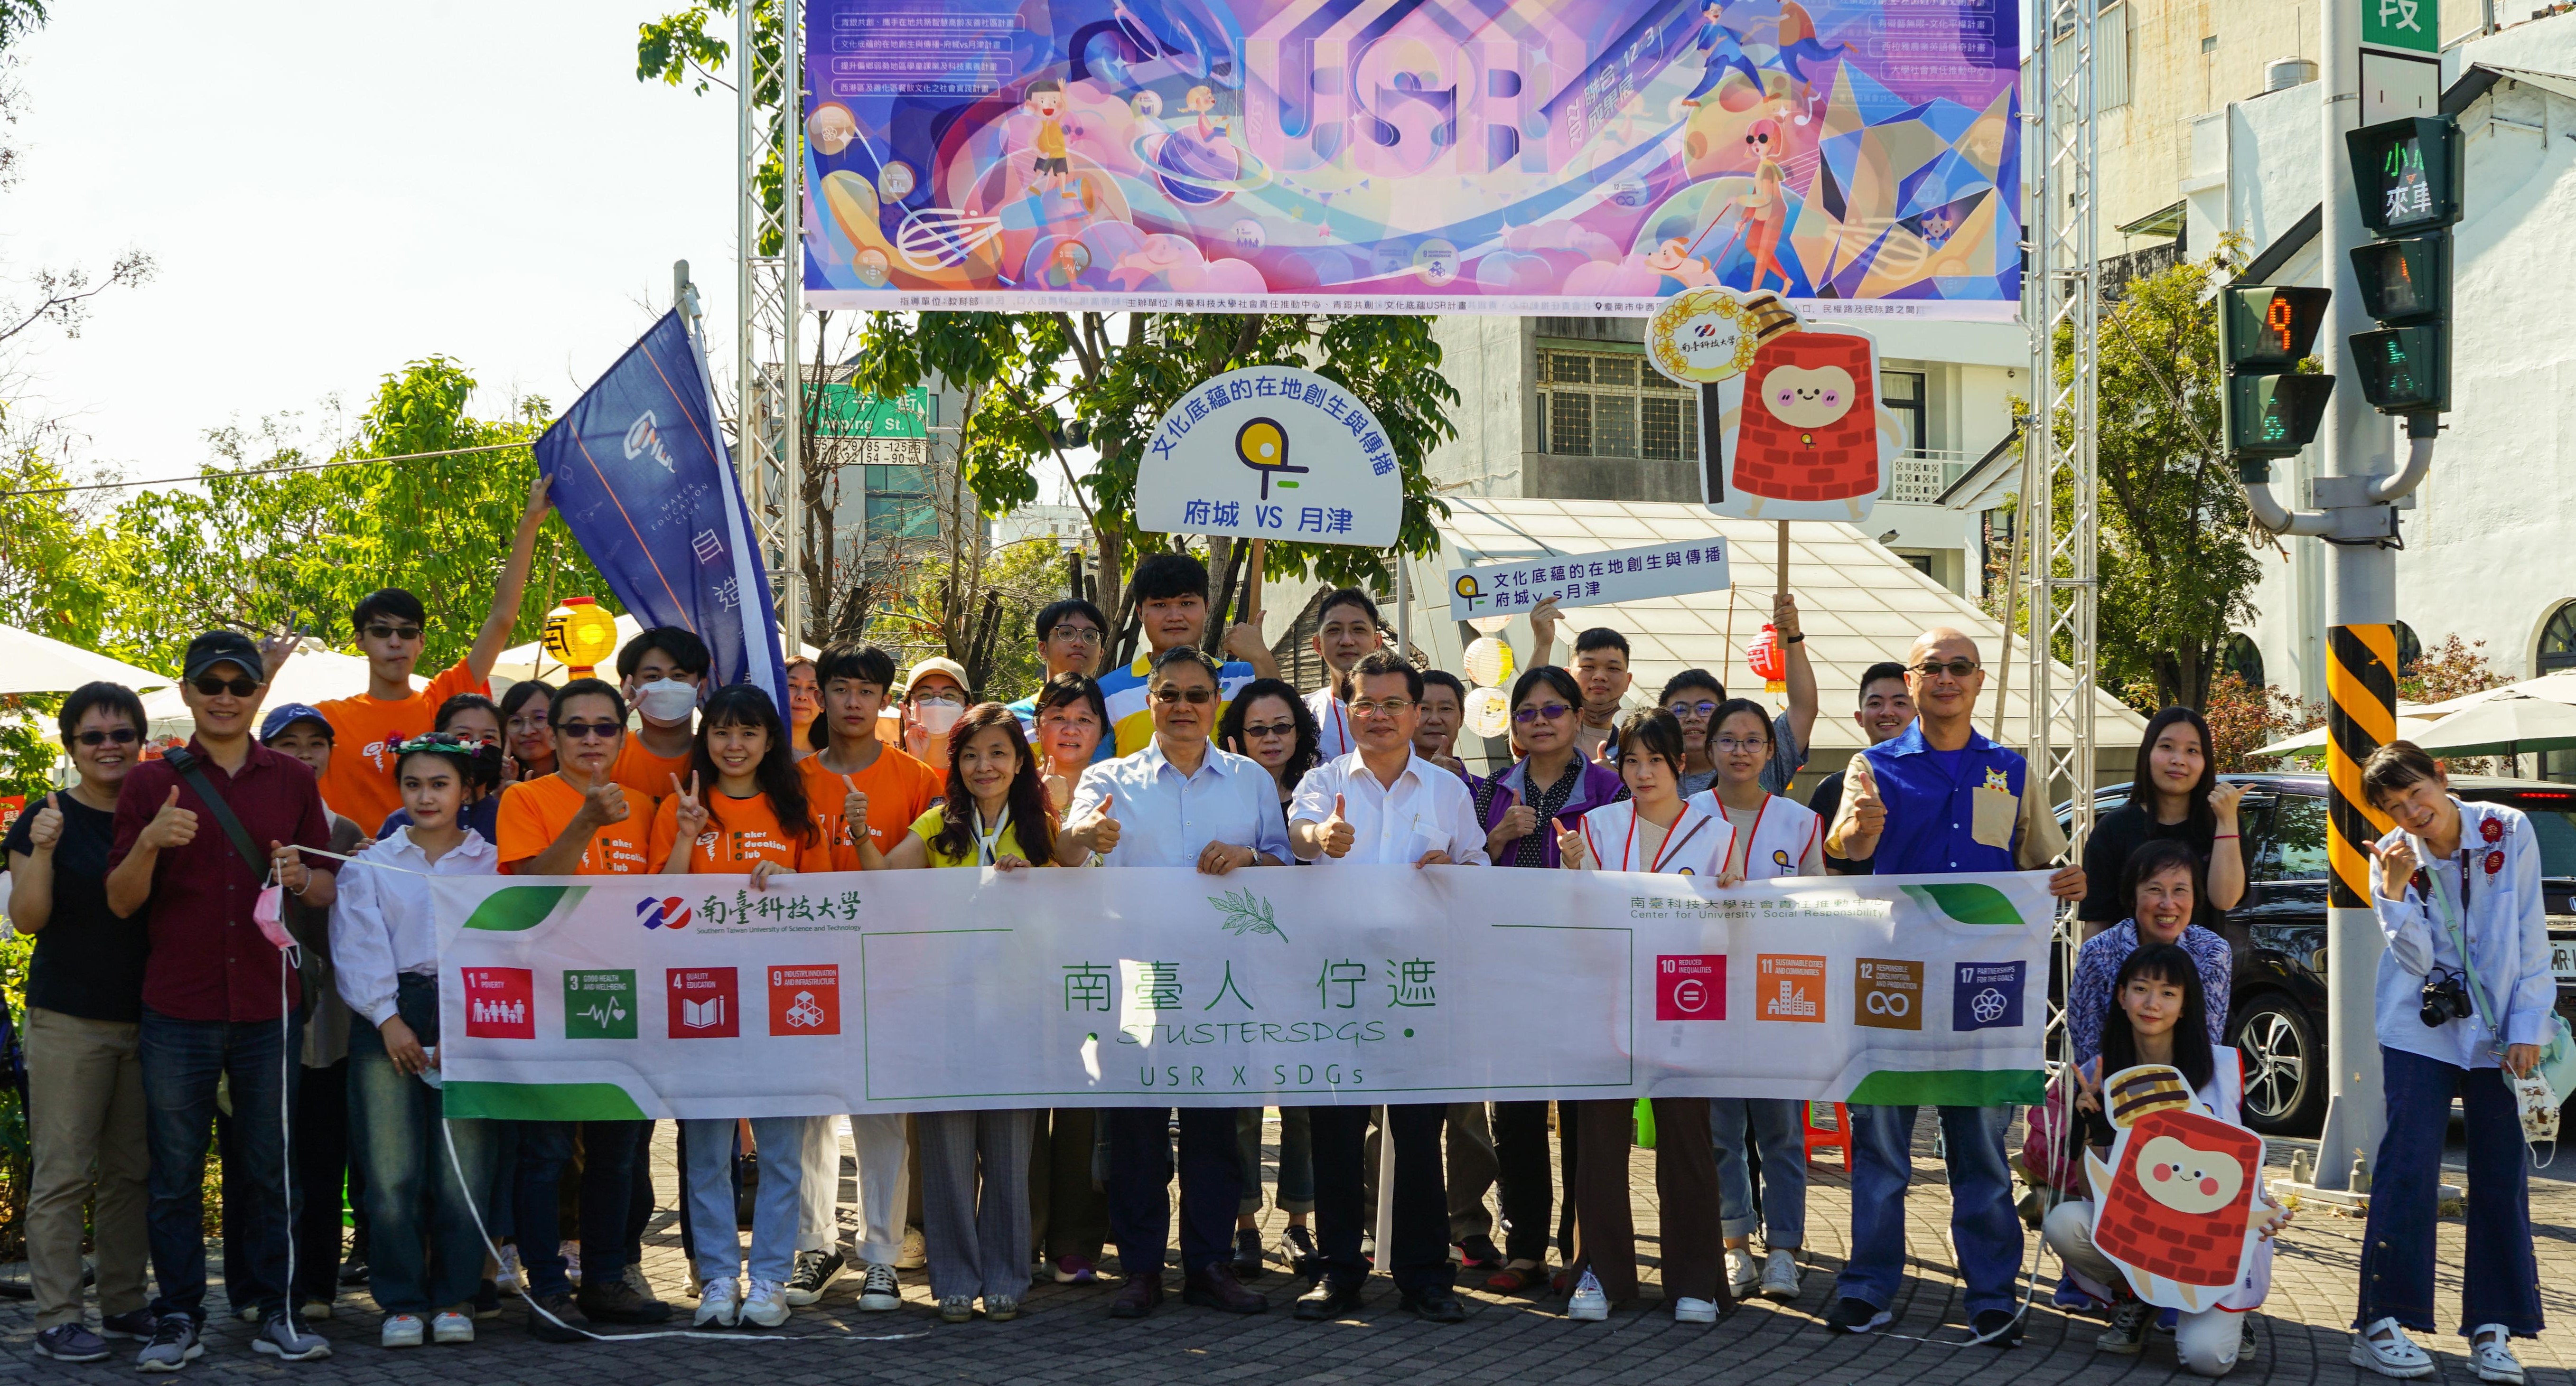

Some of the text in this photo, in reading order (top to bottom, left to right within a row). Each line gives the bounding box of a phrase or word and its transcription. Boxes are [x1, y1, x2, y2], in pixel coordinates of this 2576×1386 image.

[2268, 297, 2291, 350] 9
[885, 418, 905, 431] St.
[662, 483, 695, 512] MAKER
[651, 483, 709, 531] EDUCATION
[675, 503, 700, 525] CLUB
[1184, 499, 1353, 534] 府城 VS 月津
[1494, 546, 1721, 589] 文化底蘊的在地創生與傳播
[696, 890, 861, 925] 南臺科技大學
[1631, 897, 1886, 909] 南臺科技大學社會責任推動中心
[1631, 908, 1885, 920] Center for University Social Responsibility
[749, 926, 780, 934] University
[826, 924, 861, 933] Technology
[1661, 959, 1675, 973] 10
[1762, 959, 1772, 974] 11
[1775, 959, 1808, 967] SUSTAINABLE
[1860, 963, 1873, 978] 12
[1876, 964, 1908, 973] RESPONSIBLE
[1977, 966, 2016, 975] PARTNERSHIPS
[468, 973, 476, 988] 1
[673, 973, 682, 989] 4
[773, 971, 782, 986] 9
[796, 978, 836, 986] INFRASTRUCTURE
[1876, 973, 1911, 981] CONSUMPTION
[1961, 967, 1974, 983] 17
[570, 975, 579, 991] 3
[1062, 957, 1436, 1012] 南臺人 佇遮
[1887, 981, 1918, 990] PRODUCTION
[1140, 1063, 1363, 1086] USR X SDGs
